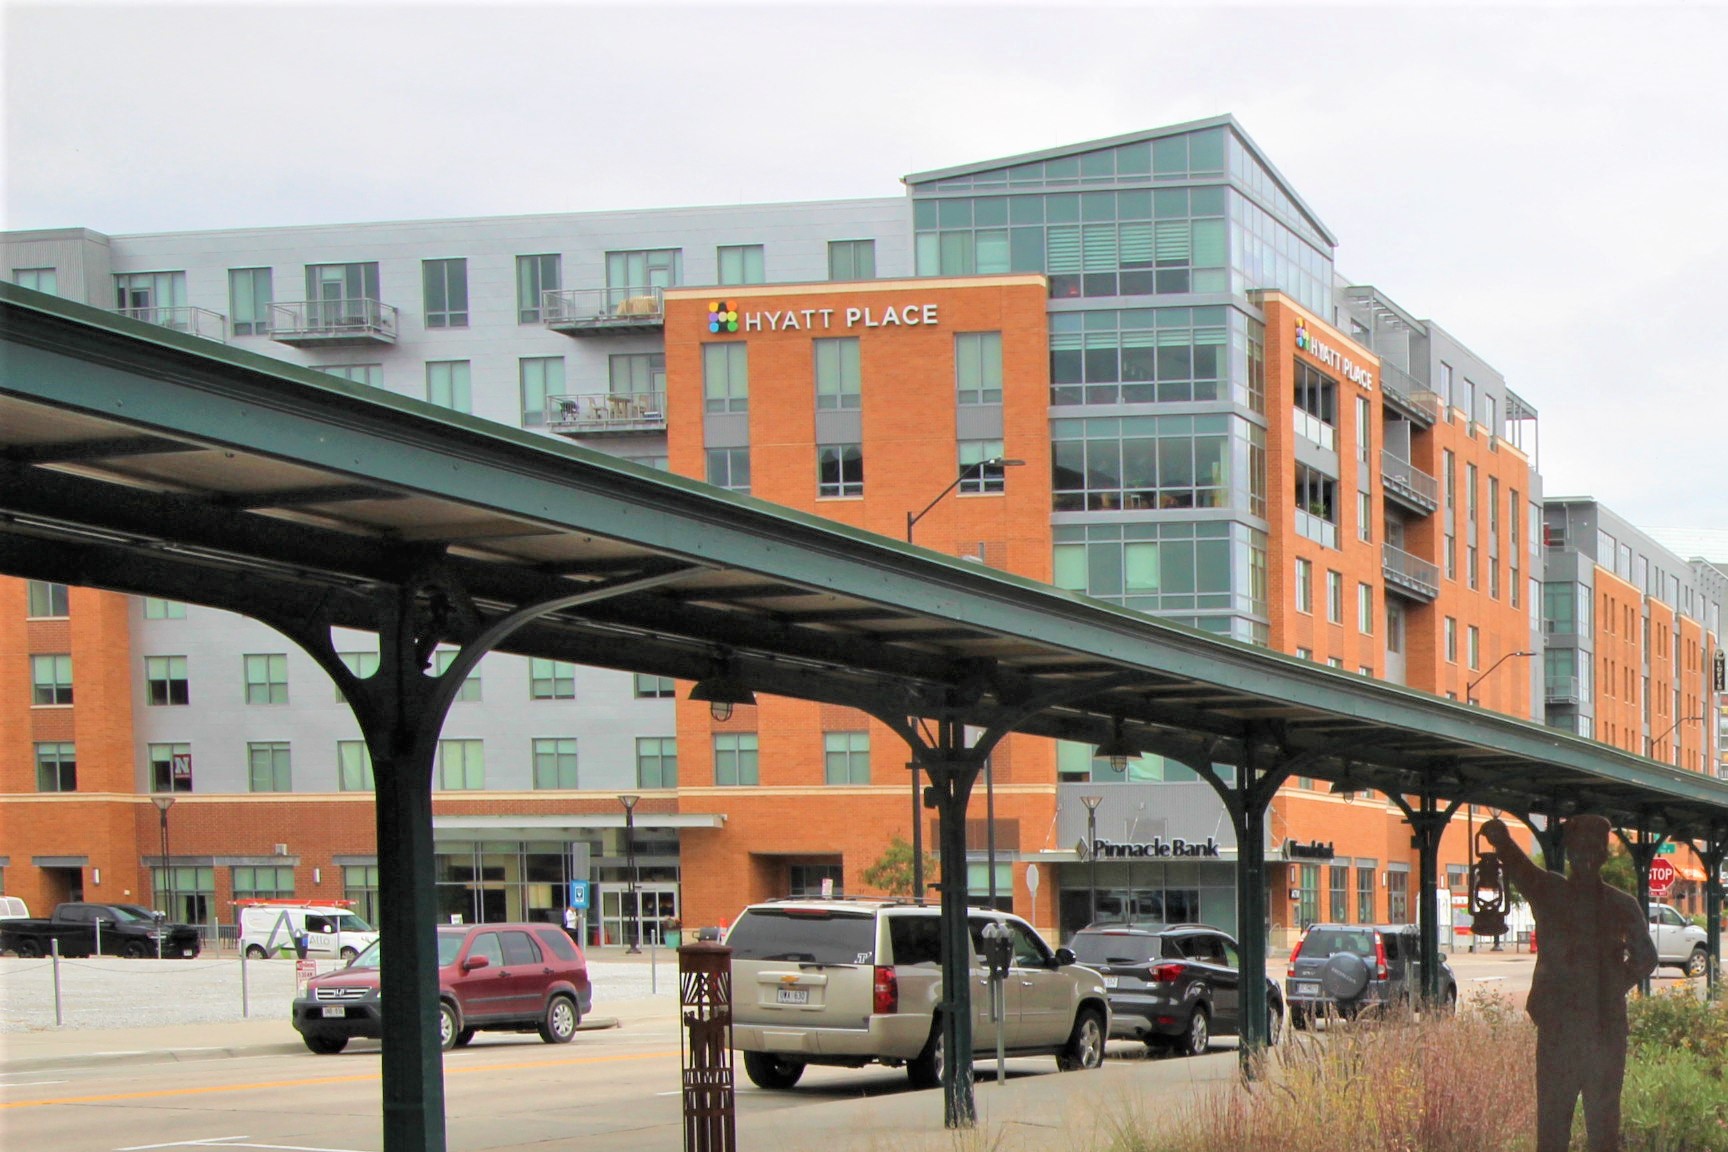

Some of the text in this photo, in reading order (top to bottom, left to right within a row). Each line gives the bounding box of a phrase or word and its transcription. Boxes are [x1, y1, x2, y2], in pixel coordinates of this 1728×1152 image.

[745, 304, 939, 332] HYATT PLACE
[1310, 336, 1373, 391] HYATT PLACE
[174, 756, 190, 774] N
[1093, 837, 1219, 857] Pinnacle Bank
